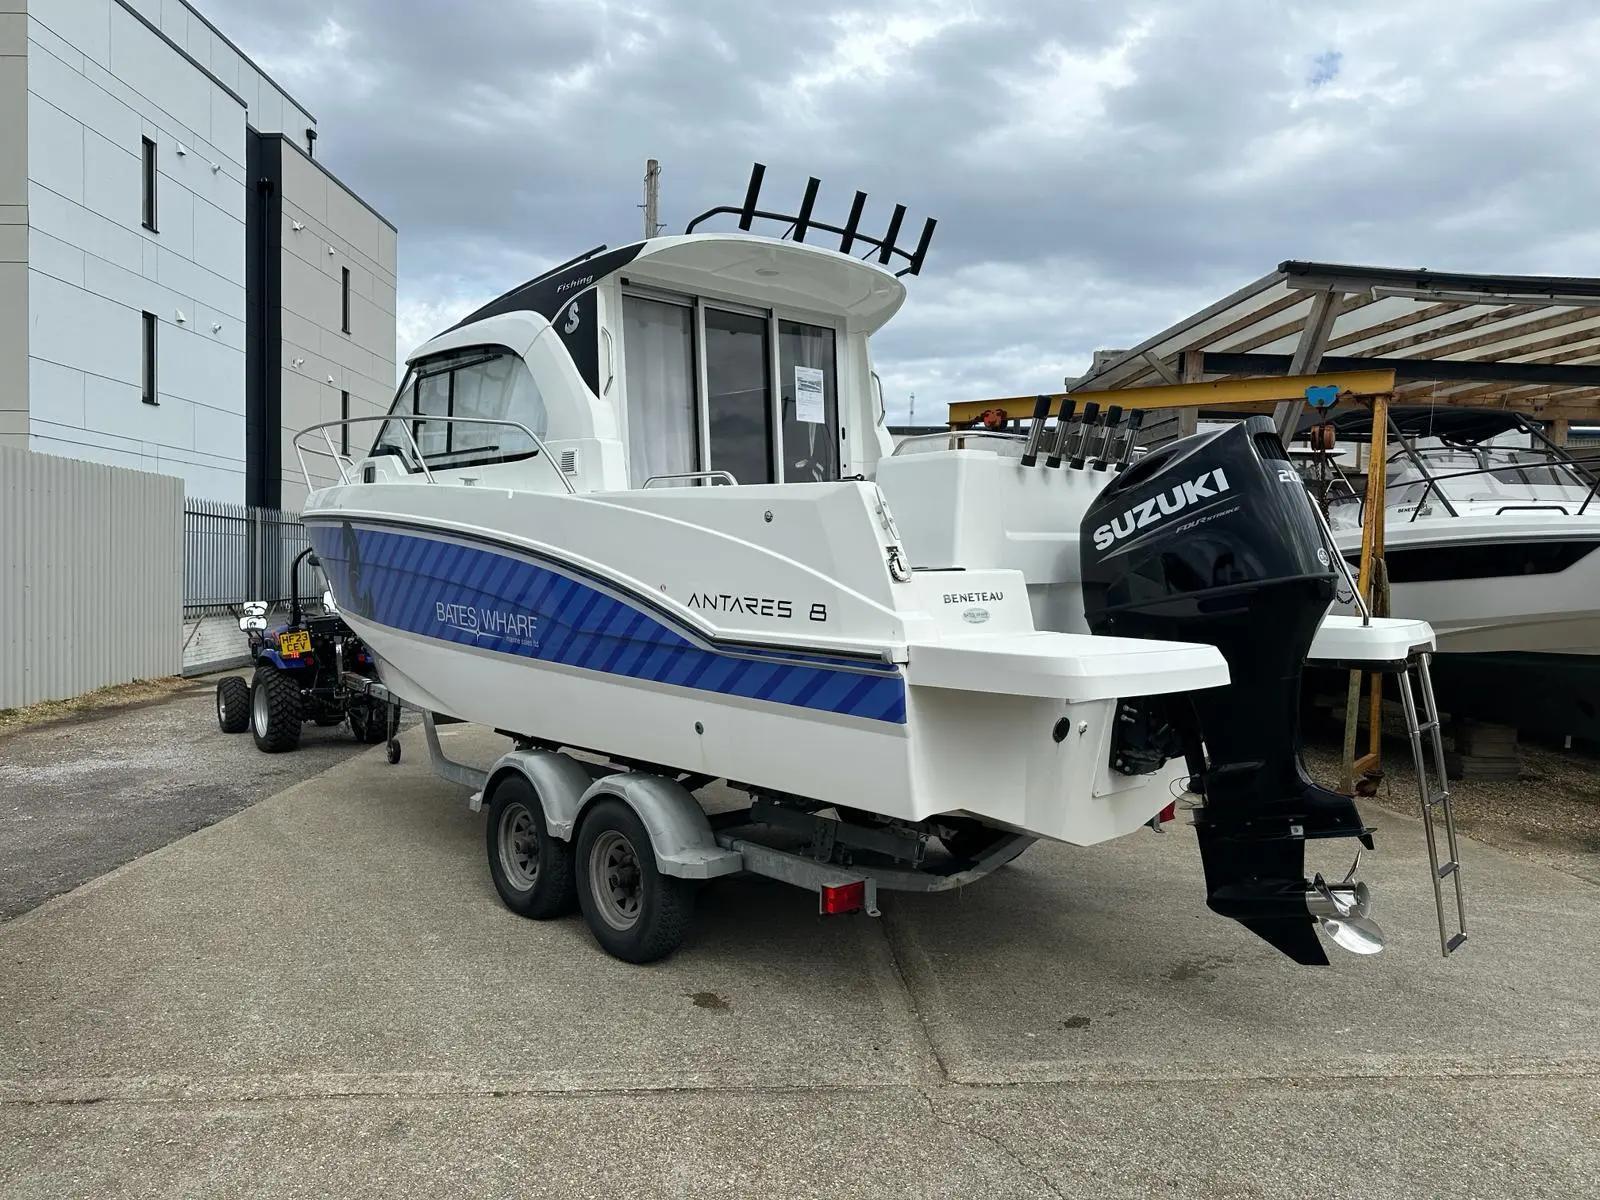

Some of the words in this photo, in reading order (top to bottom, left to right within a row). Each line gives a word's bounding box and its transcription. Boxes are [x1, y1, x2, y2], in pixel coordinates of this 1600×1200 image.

[556, 275, 593, 293] Fishing
[1277, 469, 1303, 484] 20
[1093, 467, 1230, 551] SUZUKI
[943, 591, 1004, 604] BENETEAU
[688, 592, 792, 619] ANTARES
[809, 603, 826, 621] 8
[436, 602, 477, 627] BATES
[481, 608, 538, 638] WHARF
[282, 633, 307, 645] HF23
[287, 641, 306, 652] CEV
